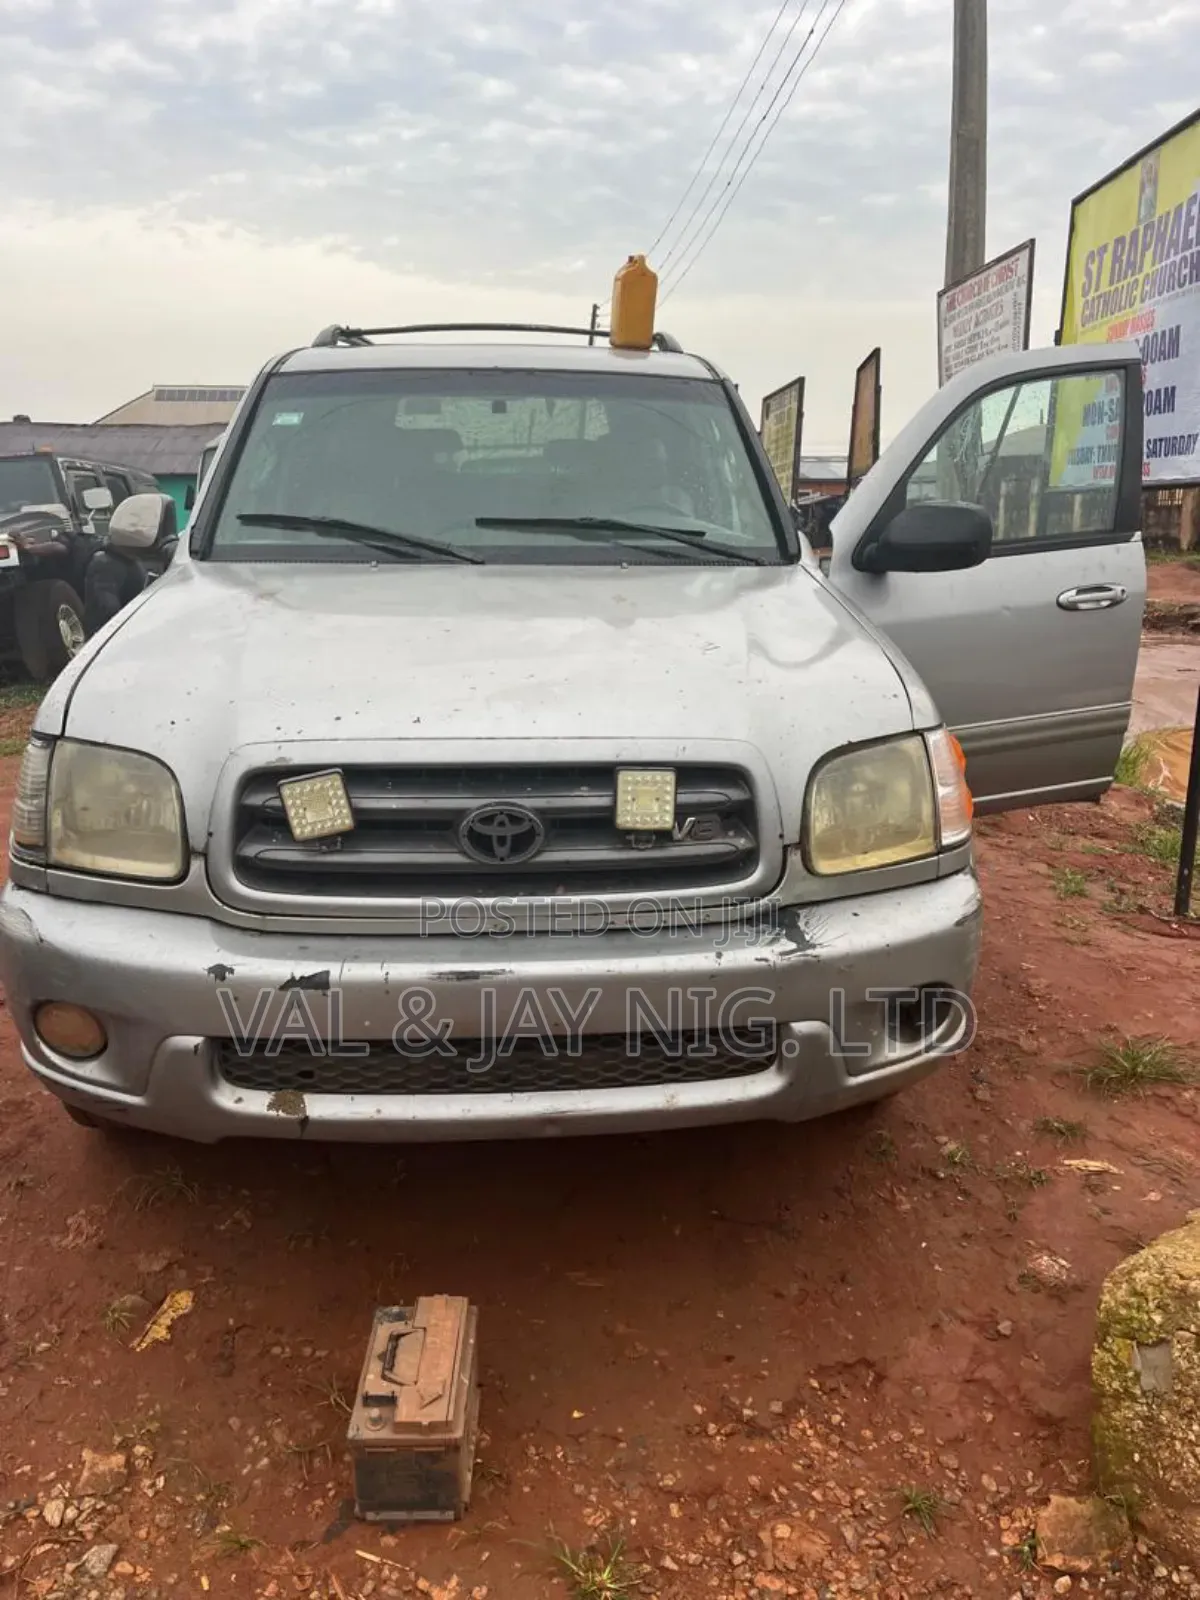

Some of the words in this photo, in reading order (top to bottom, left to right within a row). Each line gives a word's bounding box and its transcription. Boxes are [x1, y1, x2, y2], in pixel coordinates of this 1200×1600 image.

[1081, 242, 1110, 298] ST
[1081, 278, 1138, 328] CATHOLIC
[1141, 250, 1200, 303] CHURCH
[1146, 433, 1199, 459] SATURDAY
